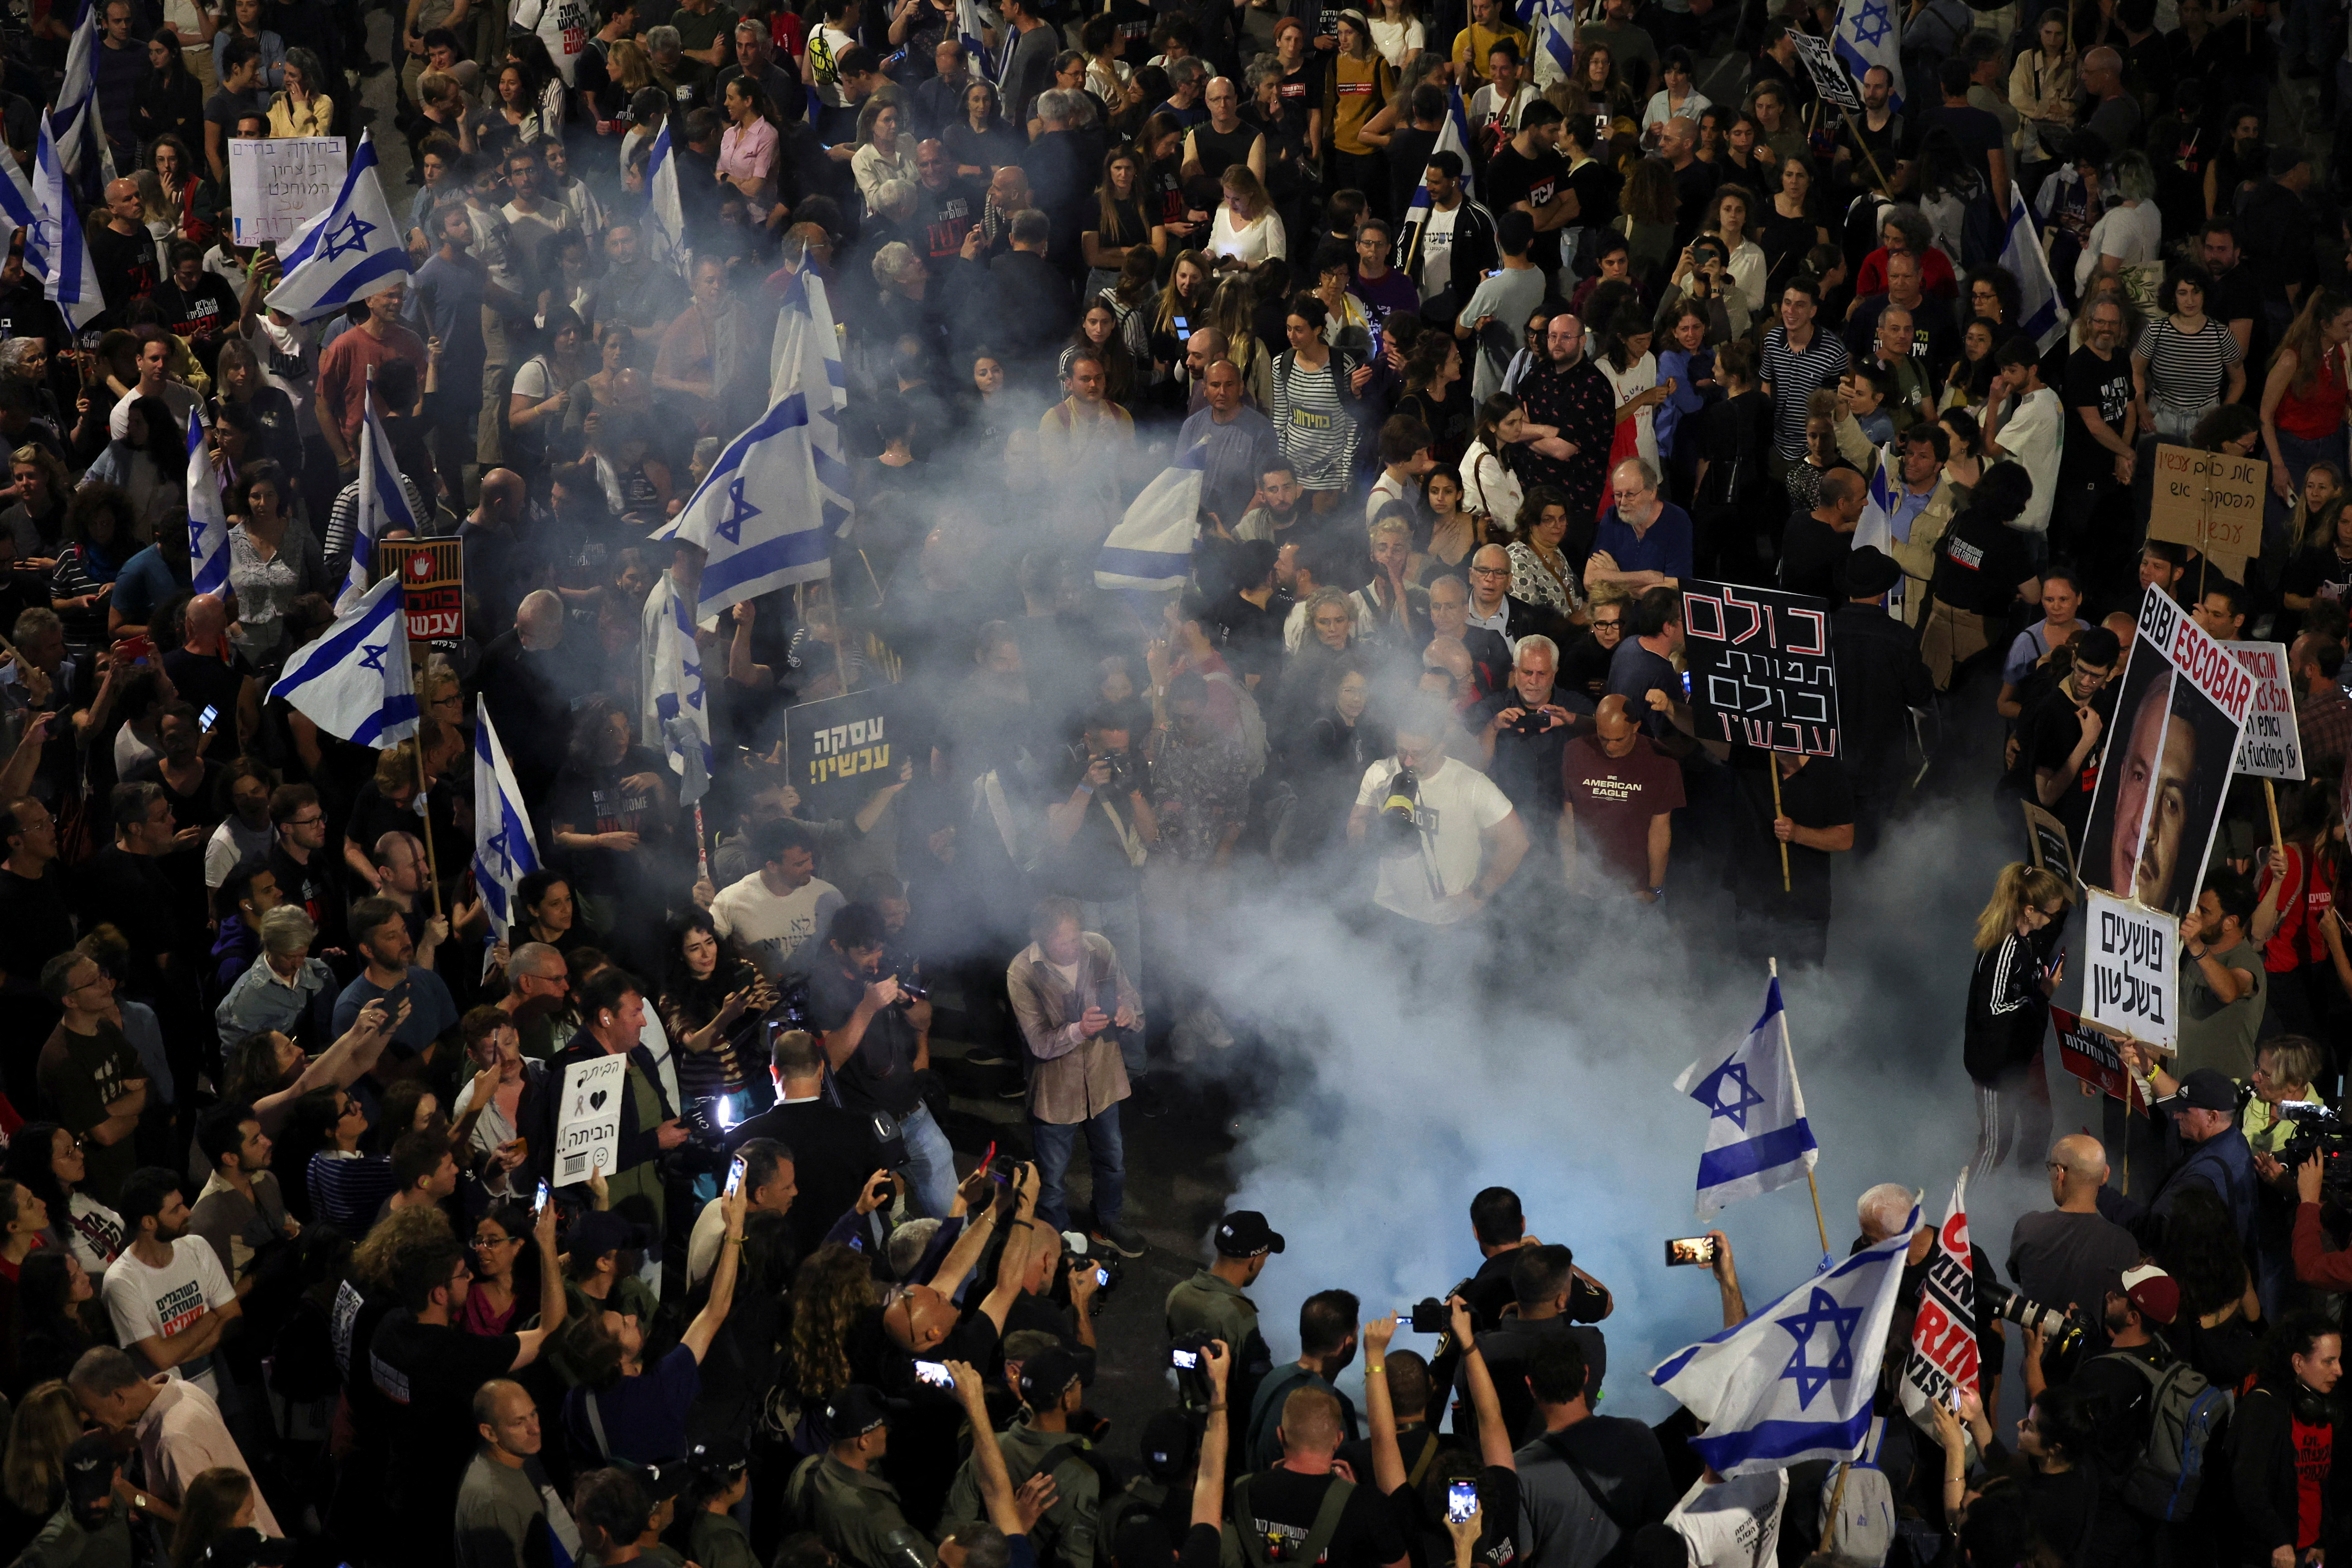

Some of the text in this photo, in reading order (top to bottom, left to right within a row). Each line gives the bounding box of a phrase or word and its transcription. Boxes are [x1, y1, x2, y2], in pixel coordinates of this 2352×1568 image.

[234, 144, 275, 155] בחיים
[269, 182, 329, 195] המוחלט
[277, 199, 304, 212] של
[1912, 343, 1928, 357] אין
[2159, 451, 2191, 472] עכשיו
[2231, 464, 2255, 484] את
[2170, 482, 2190, 498] אש
[1960, 550, 1981, 568] FORUM
[1683, 586, 1826, 656] כולם
[2140, 588, 2177, 651] BIBI
[2173, 618, 2251, 722] ESCOBAR
[1716, 650, 1834, 687] תמורת
[1708, 674, 1827, 723] כולם
[814, 716, 884, 755] עסקה
[1718, 711, 1836, 757] עכשיו
[810, 743, 889, 785] עכשיו!
[2248, 740, 2284, 775] fucking
[1582, 778, 1642, 792] AMERICAN
[1592, 788, 1629, 798] EAGLE
[623, 796, 648, 813] HOME
[2094, 960, 2165, 1025] בשלטון
[155, 1280, 200, 1311] כשהגלים
